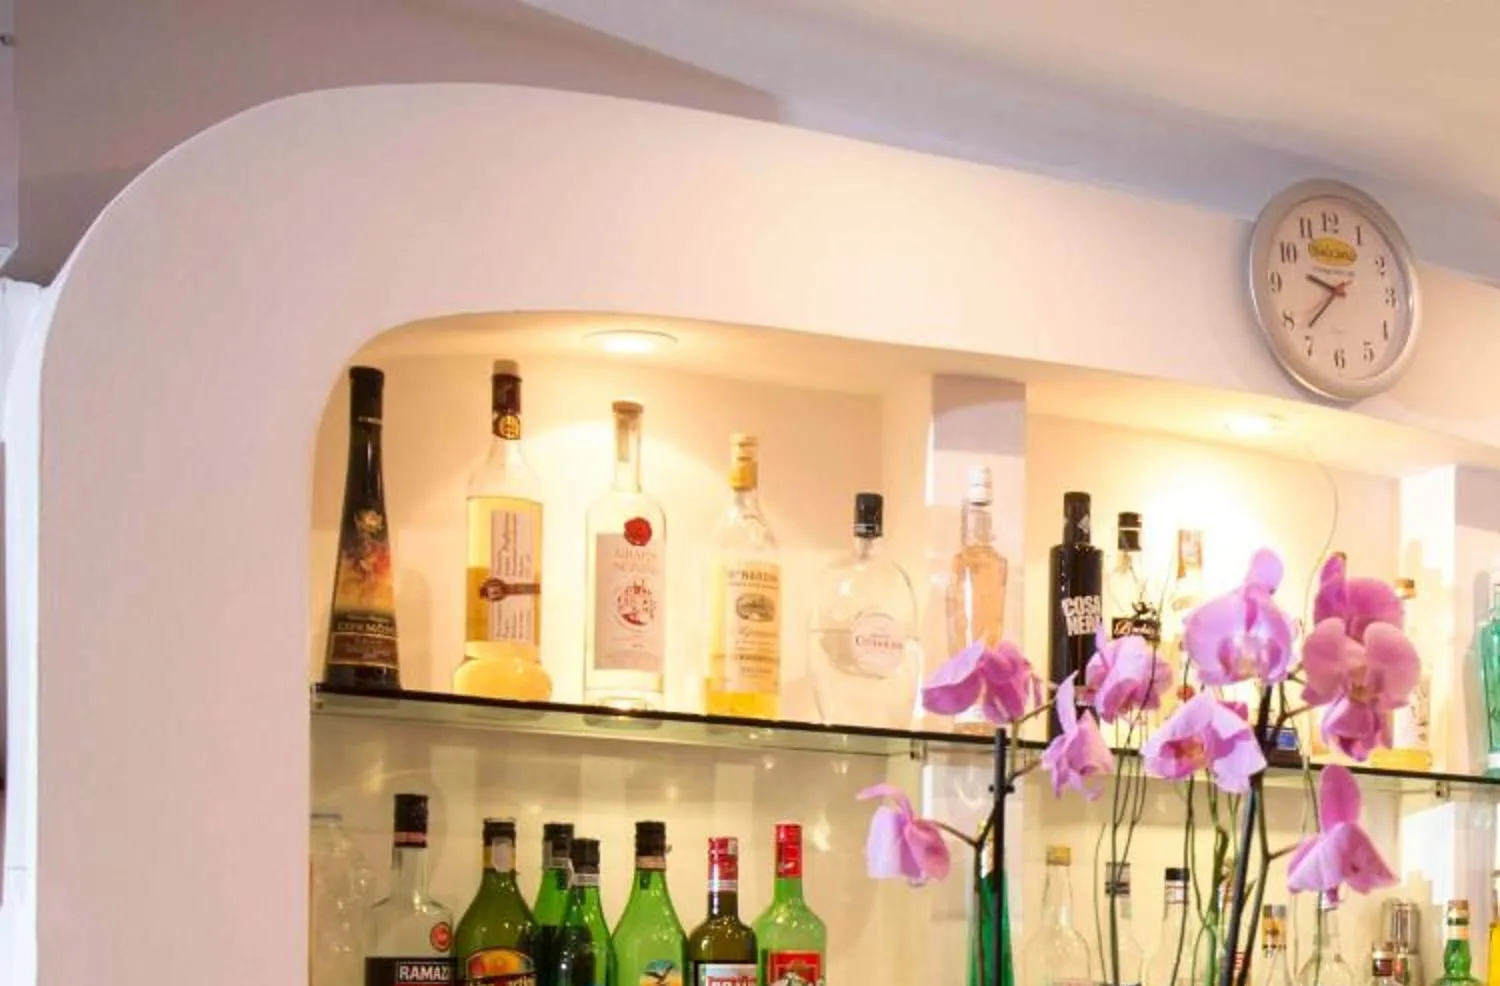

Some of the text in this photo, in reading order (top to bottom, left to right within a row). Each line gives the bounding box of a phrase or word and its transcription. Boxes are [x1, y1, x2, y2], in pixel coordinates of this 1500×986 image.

[1299, 217, 1313, 240] 11
[1321, 210, 1339, 234] 12
[1355, 225, 1362, 247] 1
[1279, 241, 1297, 264] 10
[1375, 256, 1386, 277] 2
[1269, 271, 1283, 293] 9
[1384, 287, 1397, 308] 3
[1282, 309, 1296, 332] 8
[1304, 335, 1314, 357] 7
[1363, 340, 1375, 363] 5
[1333, 348, 1346, 369] 6
[400, 964, 450, 981] RAMAZ
